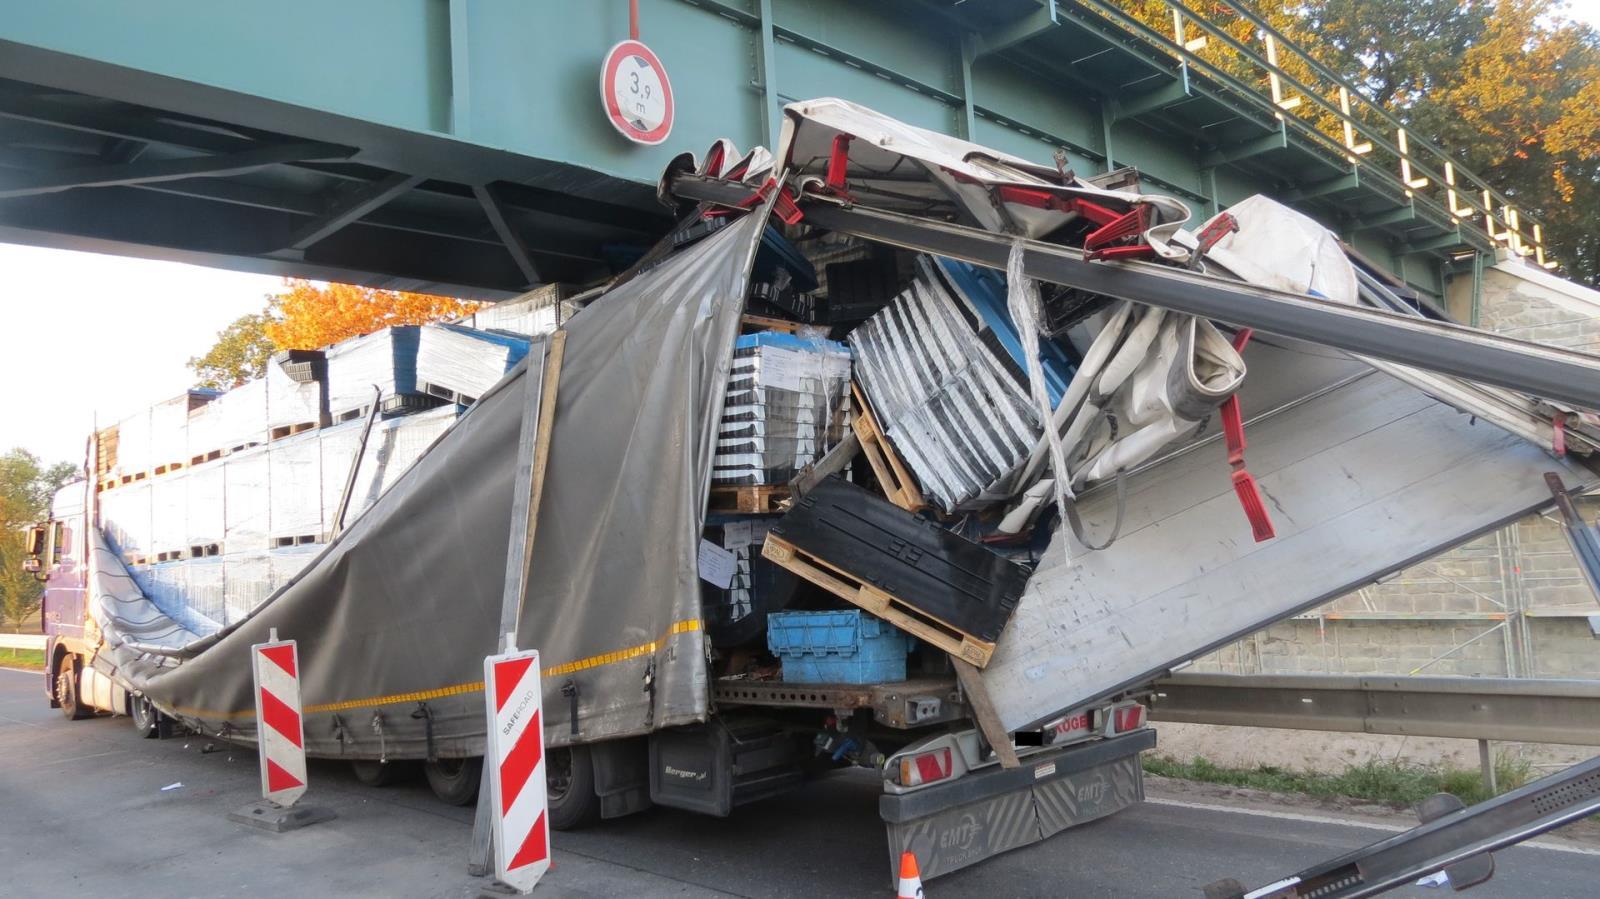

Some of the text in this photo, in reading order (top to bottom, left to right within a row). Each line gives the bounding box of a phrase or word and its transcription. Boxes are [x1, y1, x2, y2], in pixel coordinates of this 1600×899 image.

[630, 71, 651, 100] 3,9
[636, 102, 646, 114] m
[502, 689, 535, 736] SAFEROAD
[665, 765, 697, 778] Berger
